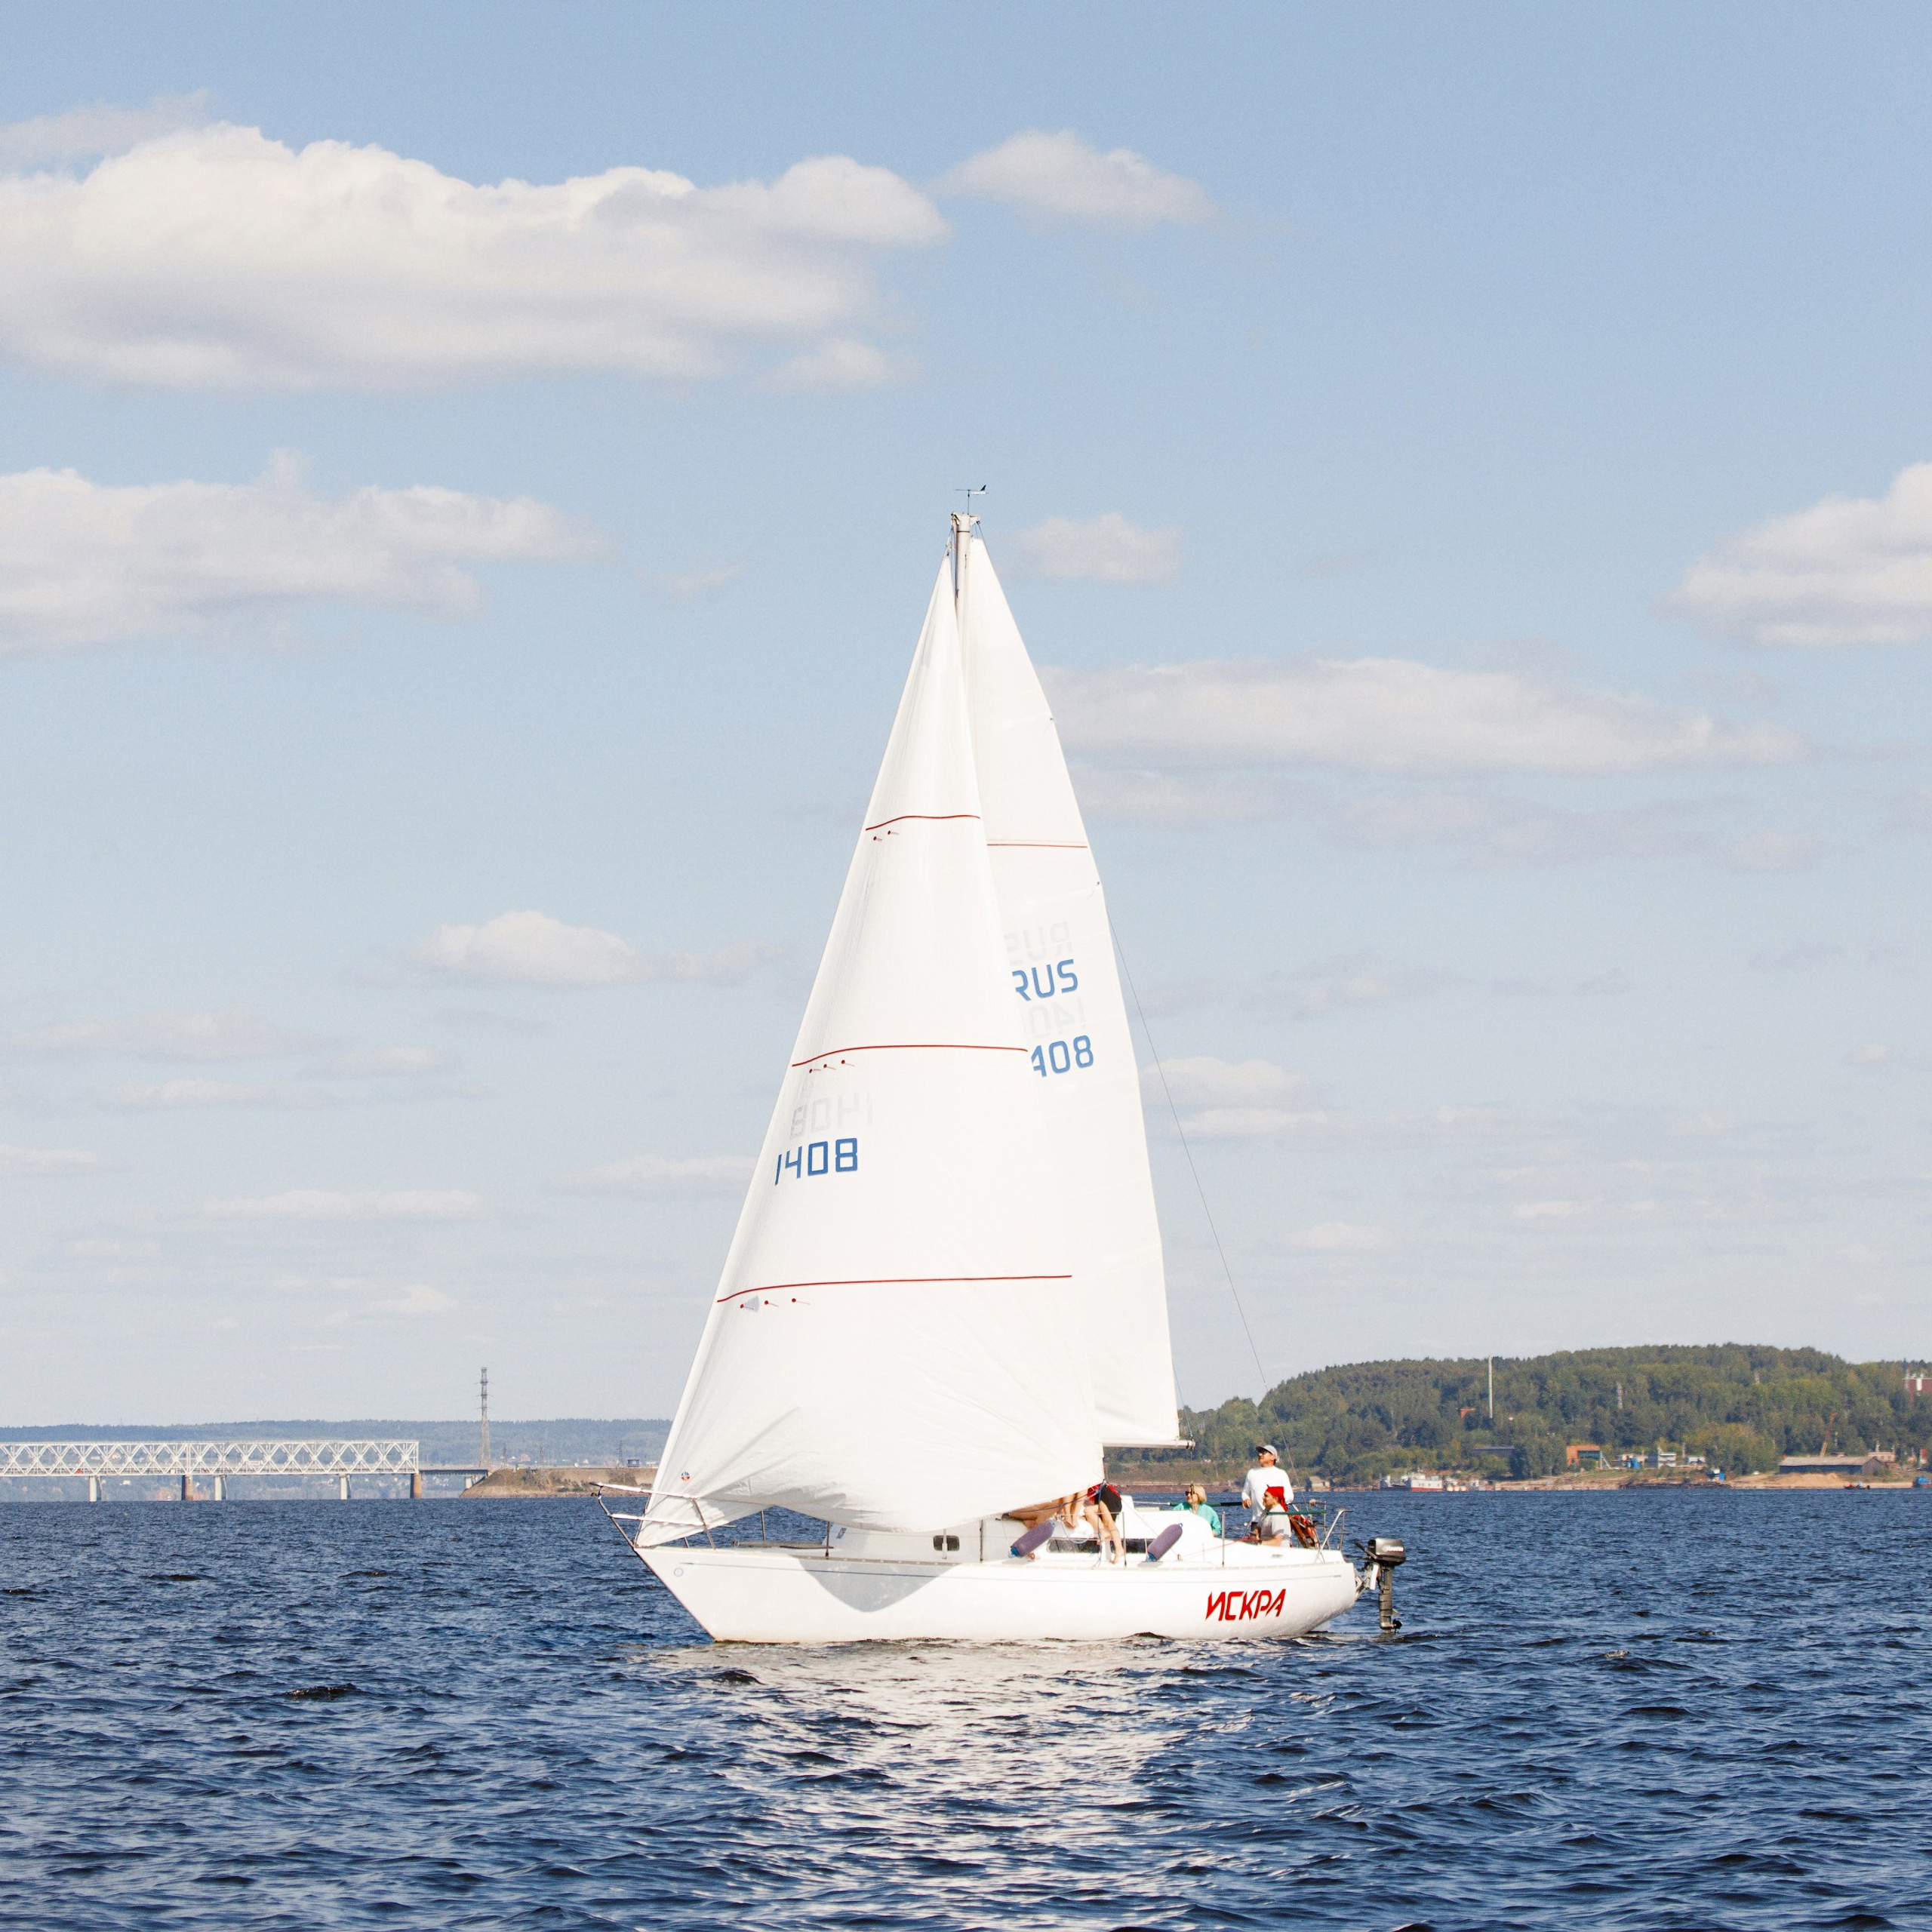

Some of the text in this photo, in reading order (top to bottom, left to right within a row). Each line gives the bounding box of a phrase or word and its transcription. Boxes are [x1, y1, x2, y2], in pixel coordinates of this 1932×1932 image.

[1012, 958, 1078, 1001] RUS
[774, 1137, 858, 1186] 1408
[1205, 1588, 1287, 1622] ИСКРА
